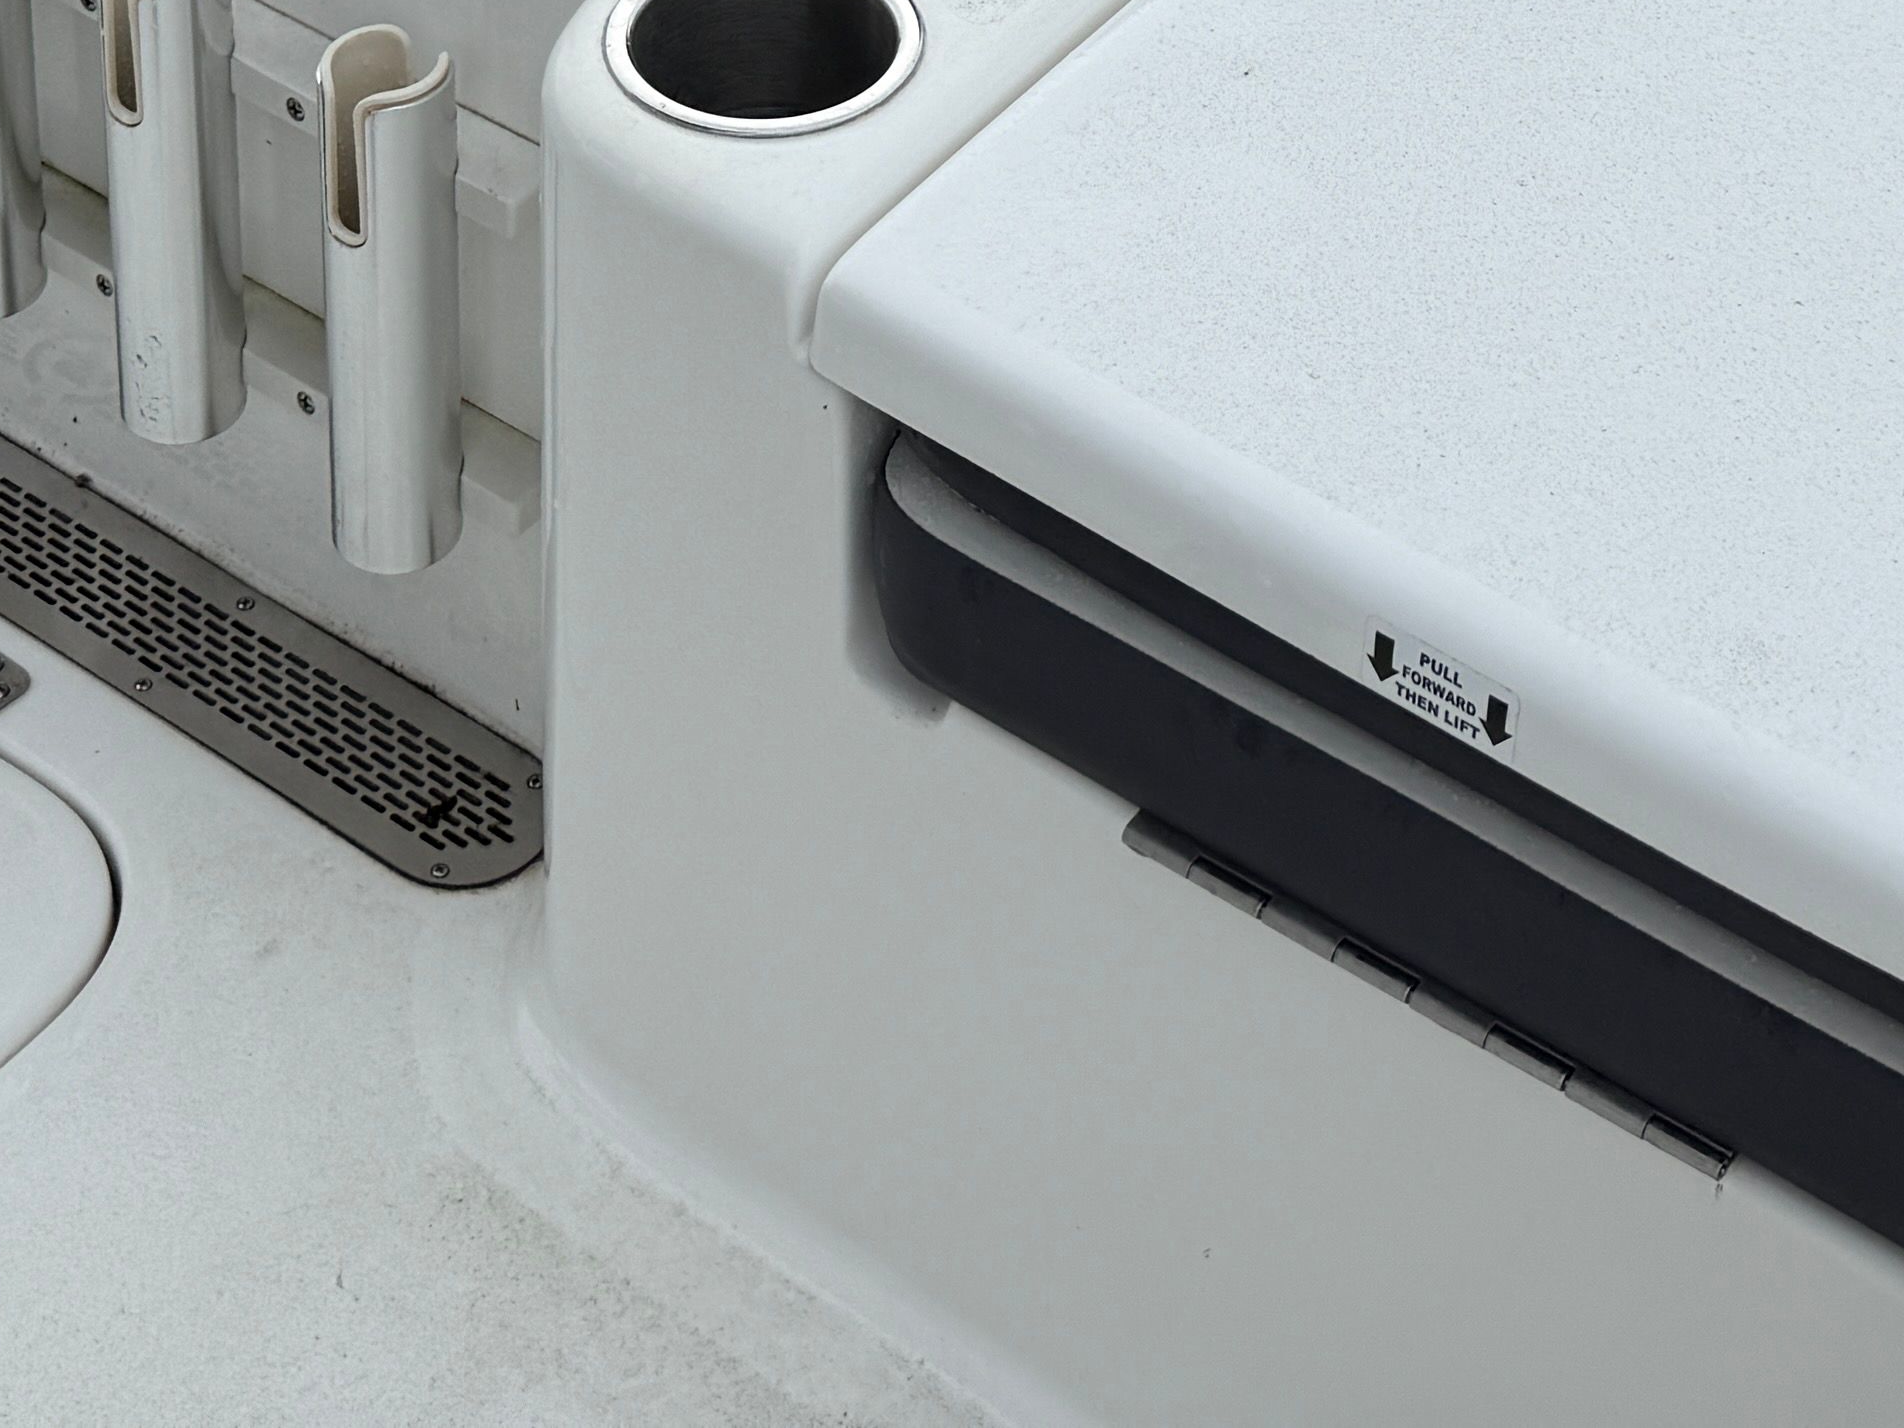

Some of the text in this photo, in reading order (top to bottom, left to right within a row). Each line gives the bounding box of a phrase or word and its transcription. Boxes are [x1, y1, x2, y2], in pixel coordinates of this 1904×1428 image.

[1402, 664, 1476, 716] FORWARD
[1419, 652, 1462, 688] PULL
[1395, 681, 1480, 739] THEN LIFT
